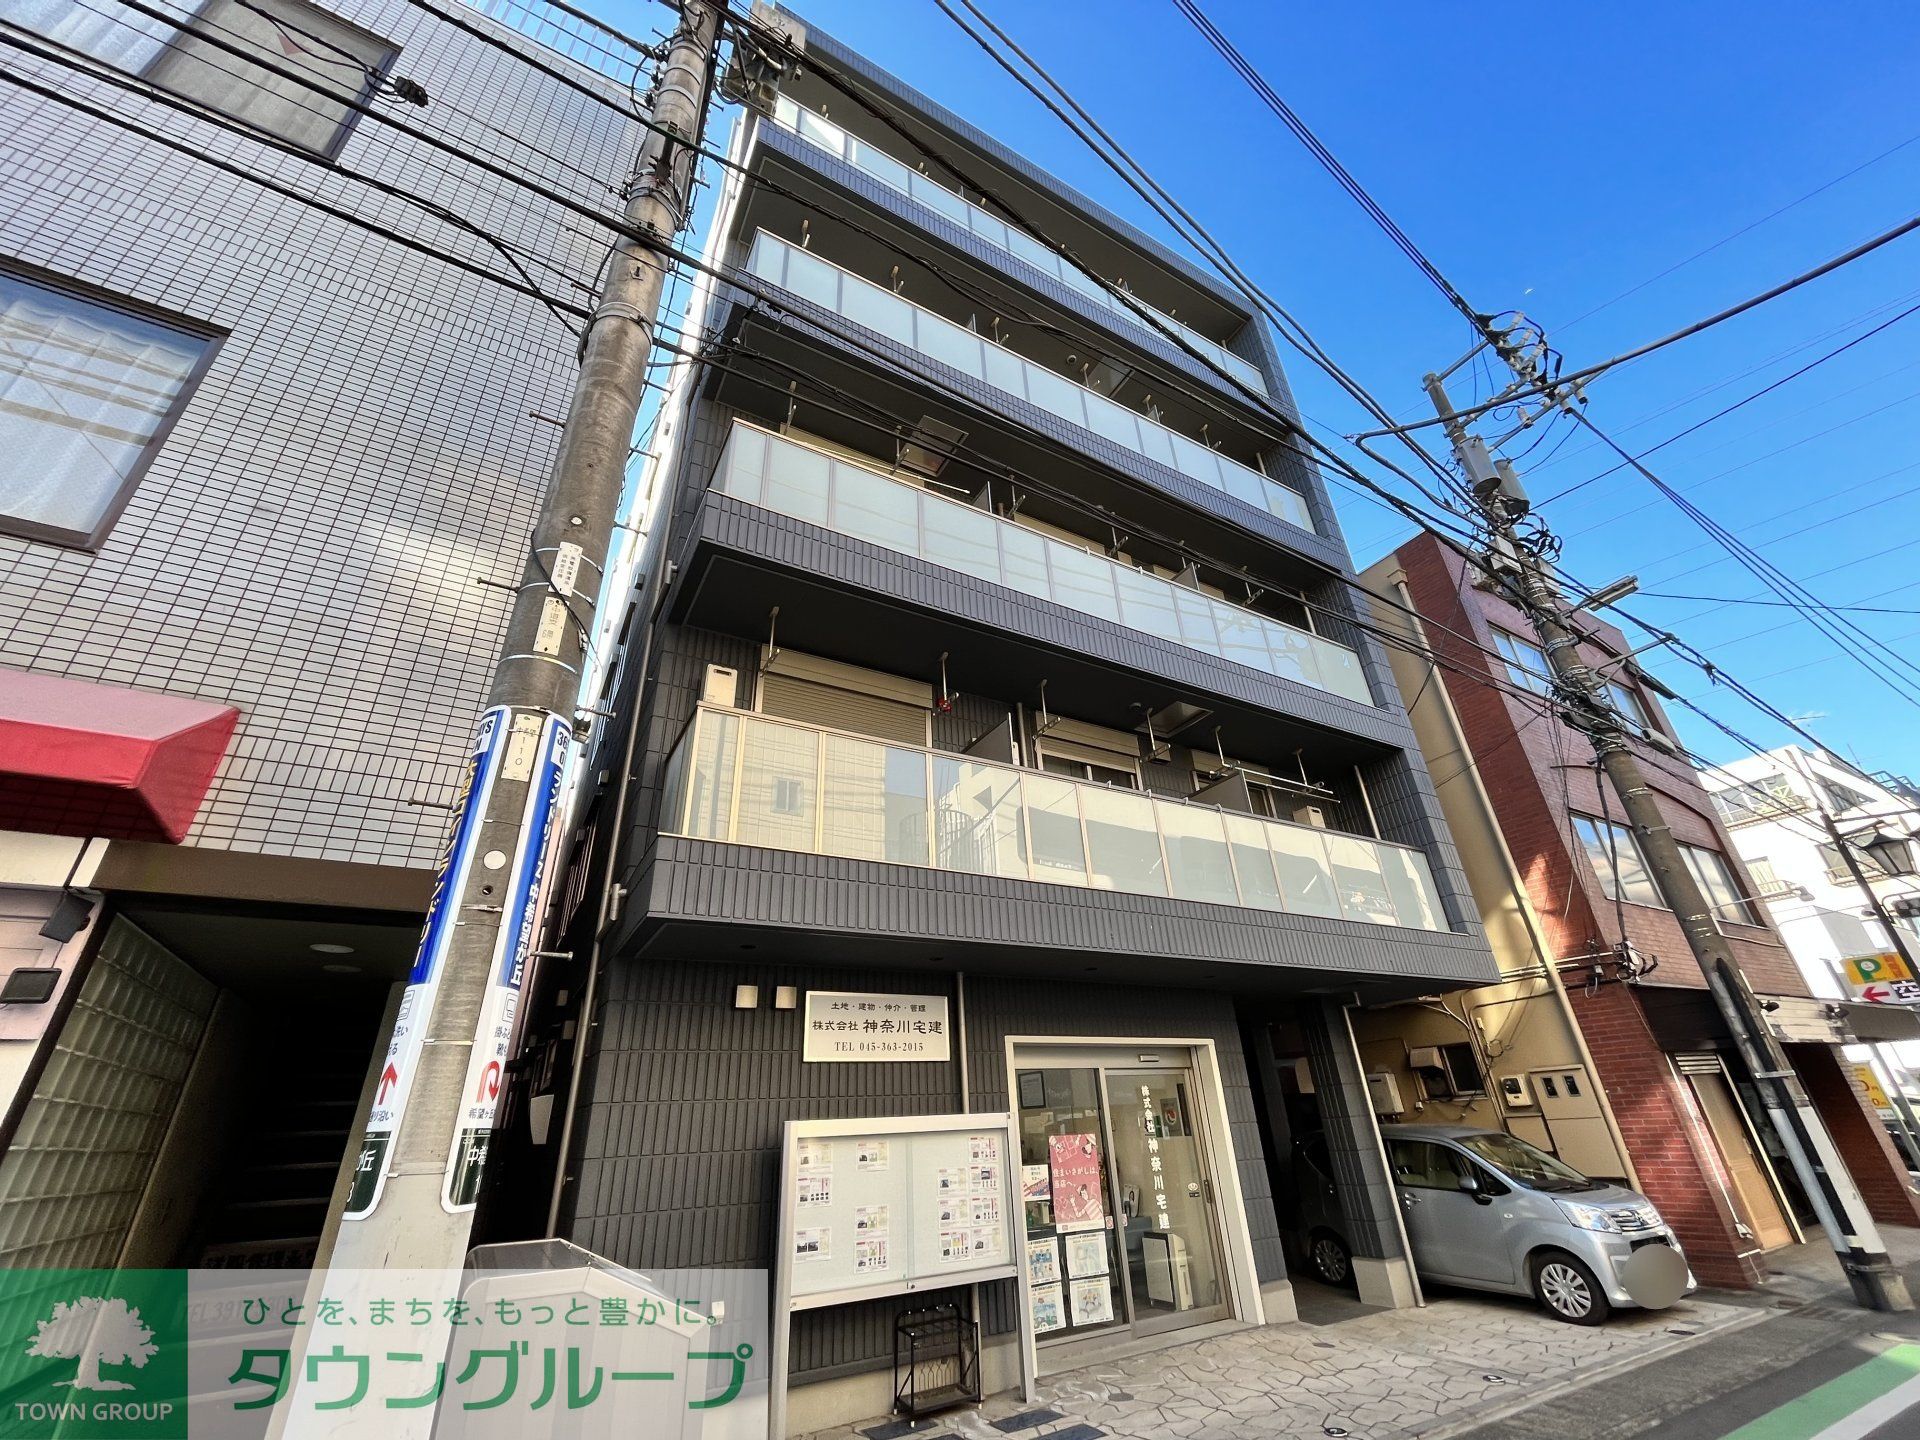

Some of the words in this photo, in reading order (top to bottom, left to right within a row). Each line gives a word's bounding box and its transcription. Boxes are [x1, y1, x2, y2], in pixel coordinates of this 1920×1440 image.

[812, 1020, 858, 1031] 株式会社
[863, 1019, 943, 1034] 神奈川宅建
[834, 1041, 854, 1051] TEL
[859, 1042, 924, 1052] 045-363-2015
[1141, 1085, 1156, 1133] 株式会社
[1148, 1138, 1171, 1230] 神奈川宅建
